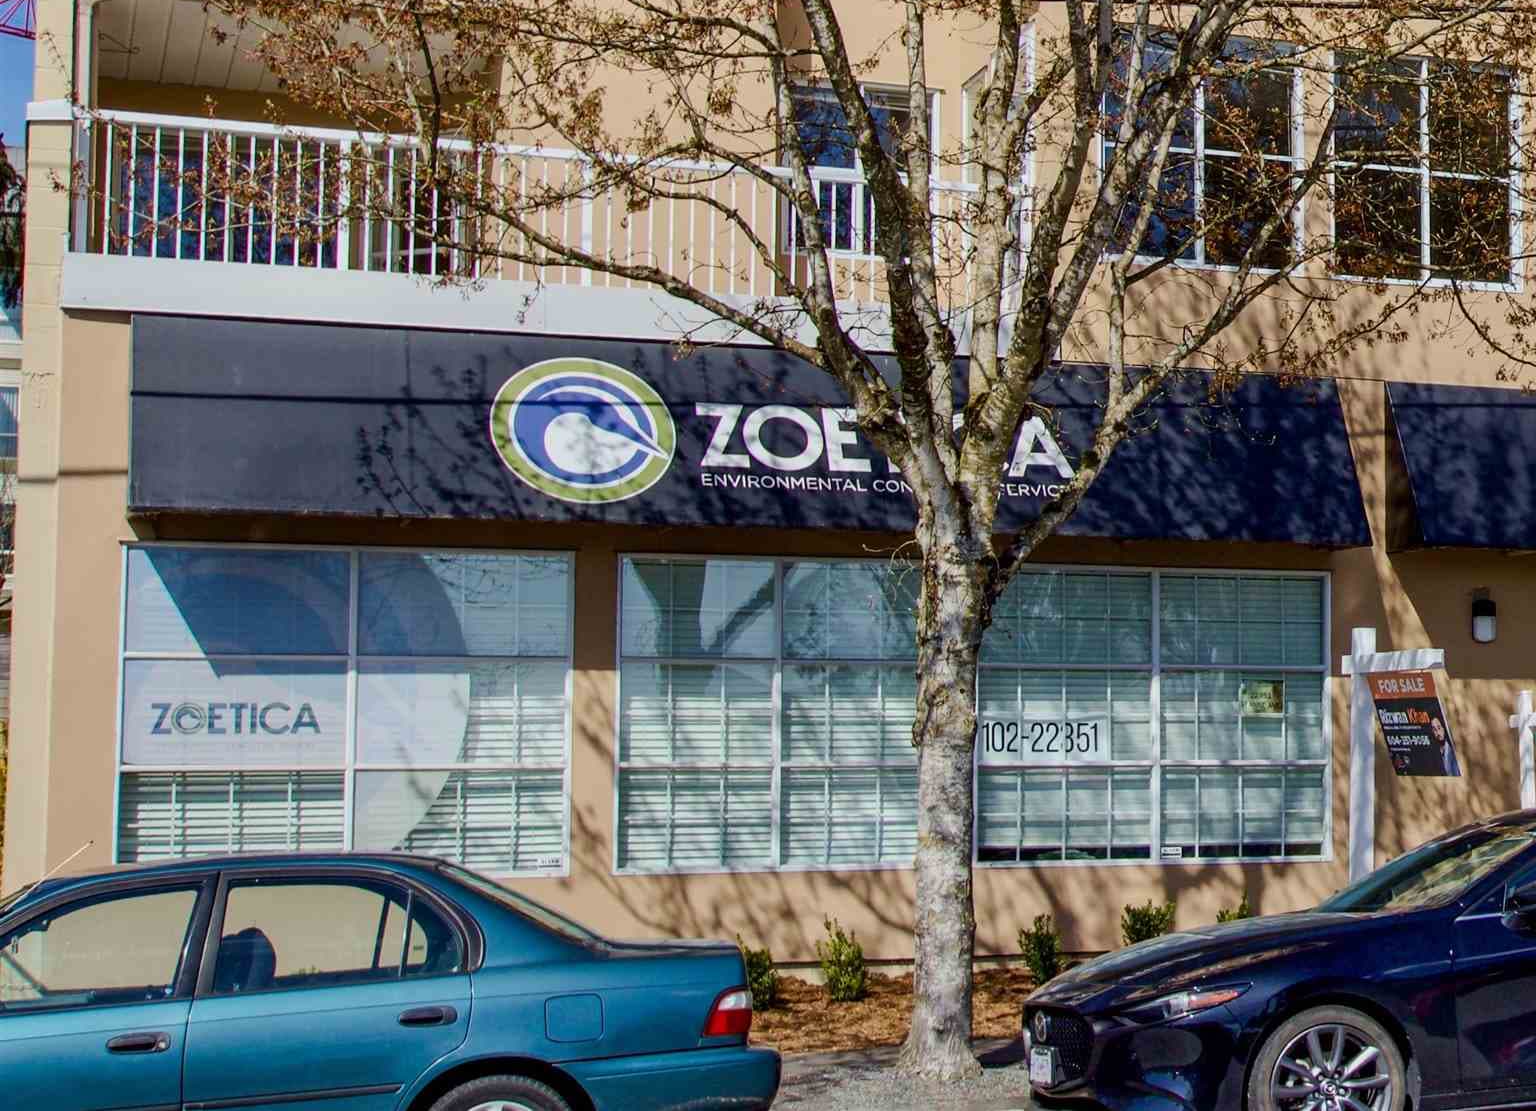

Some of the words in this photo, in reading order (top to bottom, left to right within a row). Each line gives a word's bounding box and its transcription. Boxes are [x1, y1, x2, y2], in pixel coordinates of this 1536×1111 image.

[695, 402, 1077, 479] ZOEA
[702, 473, 868, 492] ENVIRONMENTAL
[1377, 679, 1399, 694] FOR
[1400, 677, 1425, 693] SALE
[150, 701, 322, 736] ZOETICA
